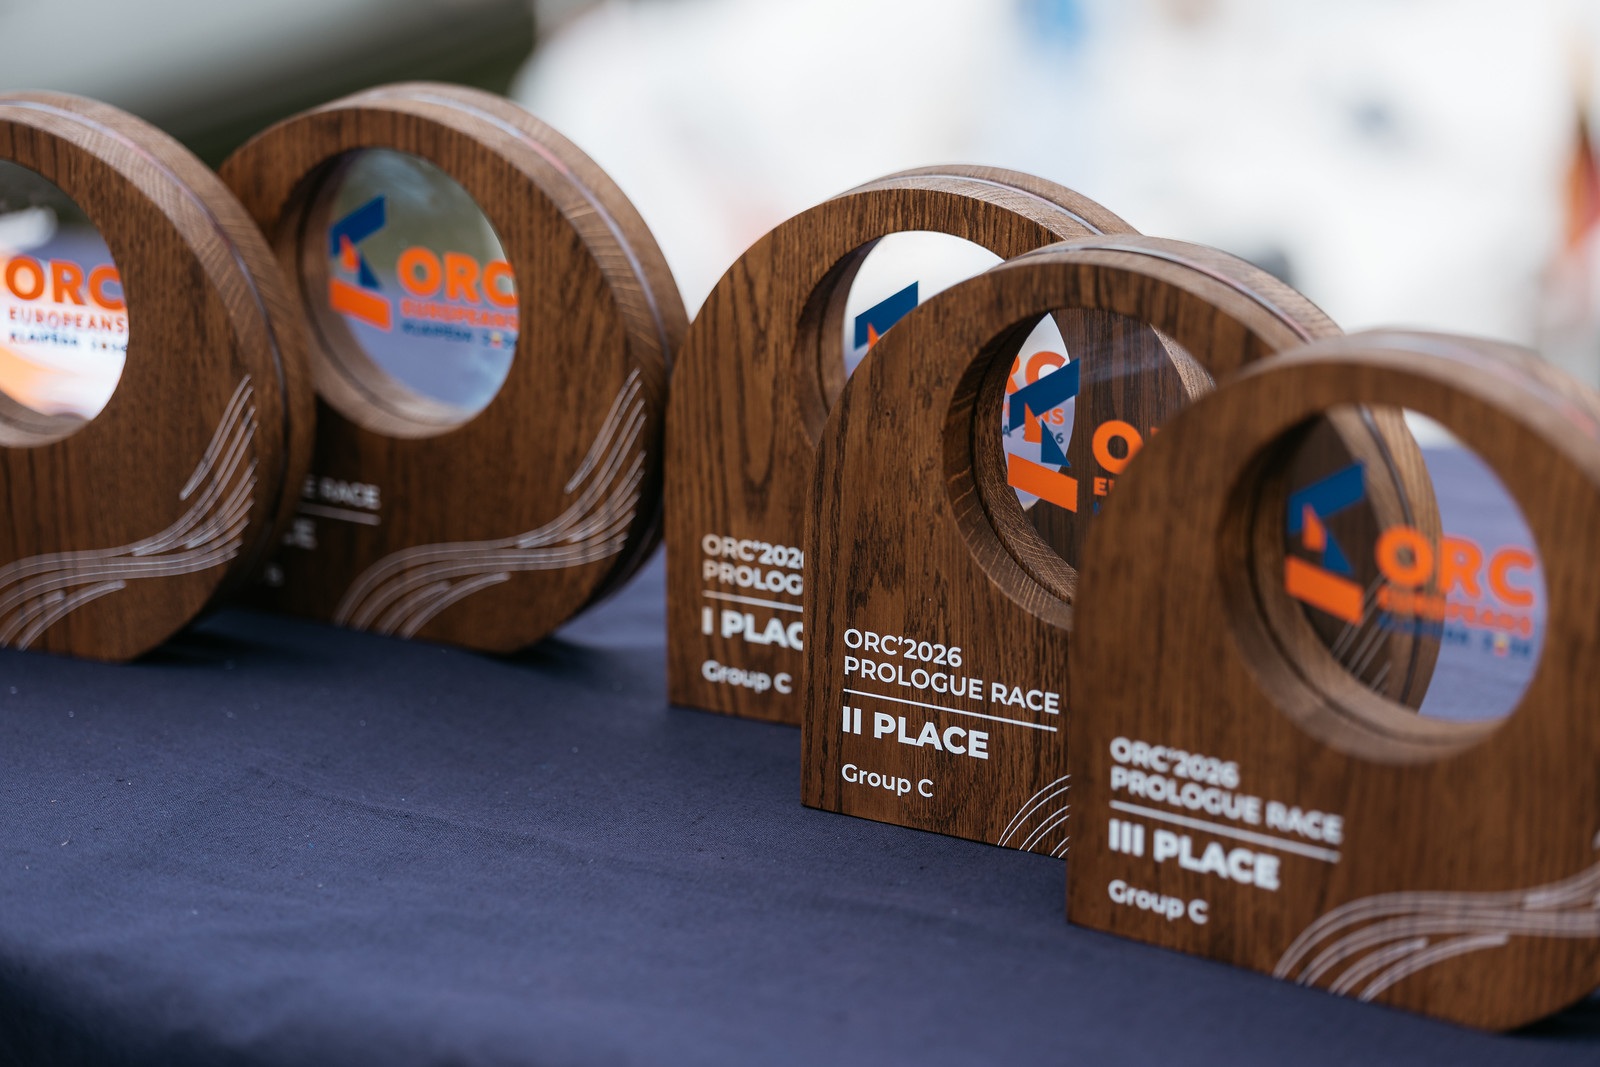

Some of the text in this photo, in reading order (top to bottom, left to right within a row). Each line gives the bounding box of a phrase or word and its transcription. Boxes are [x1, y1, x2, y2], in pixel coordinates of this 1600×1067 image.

[5, 255, 127, 311] ORC
[397, 246, 519, 309] ORC
[9, 306, 125, 333] EUROPEANS
[702, 560, 804, 596] PROLOG
[1375, 522, 1535, 607] ORC
[721, 609, 803, 651] PLAC
[843, 628, 962, 668] ORC'2026
[701, 660, 792, 694] Group C
[844, 655, 1060, 715] PROLOGUE RACE
[842, 706, 989, 760] II PLACE
[841, 763, 934, 798] Group C
[1110, 765, 1343, 845] PROLOGUE RACE
[1108, 818, 1280, 891] III PLACE
[1107, 879, 1209, 925] Group C
